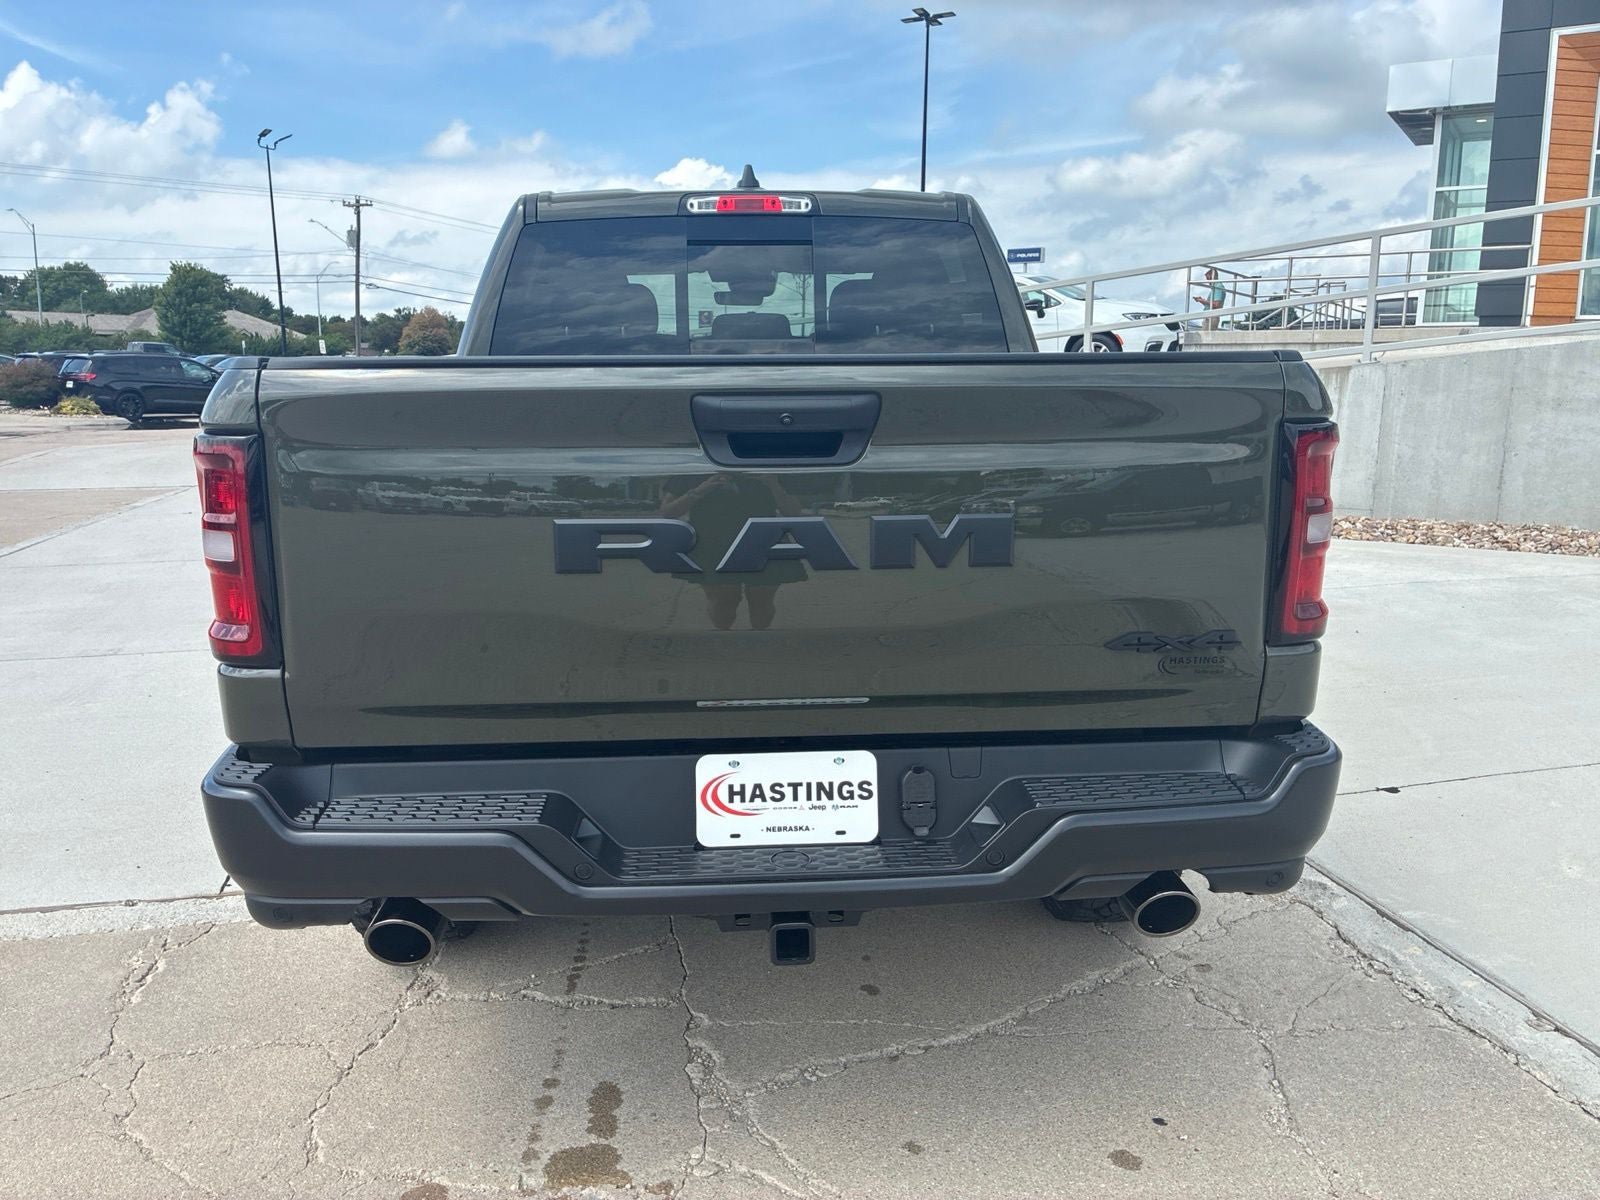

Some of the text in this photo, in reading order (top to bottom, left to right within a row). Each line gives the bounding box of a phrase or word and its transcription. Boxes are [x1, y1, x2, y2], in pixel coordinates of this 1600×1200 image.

[553, 513, 1015, 573] RAM
[1169, 655, 1225, 665] HASTINGS
[727, 780, 874, 804] HASTINGS
[808, 803, 827, 812] Jeep
[765, 825, 811, 833] NEBRASKA
